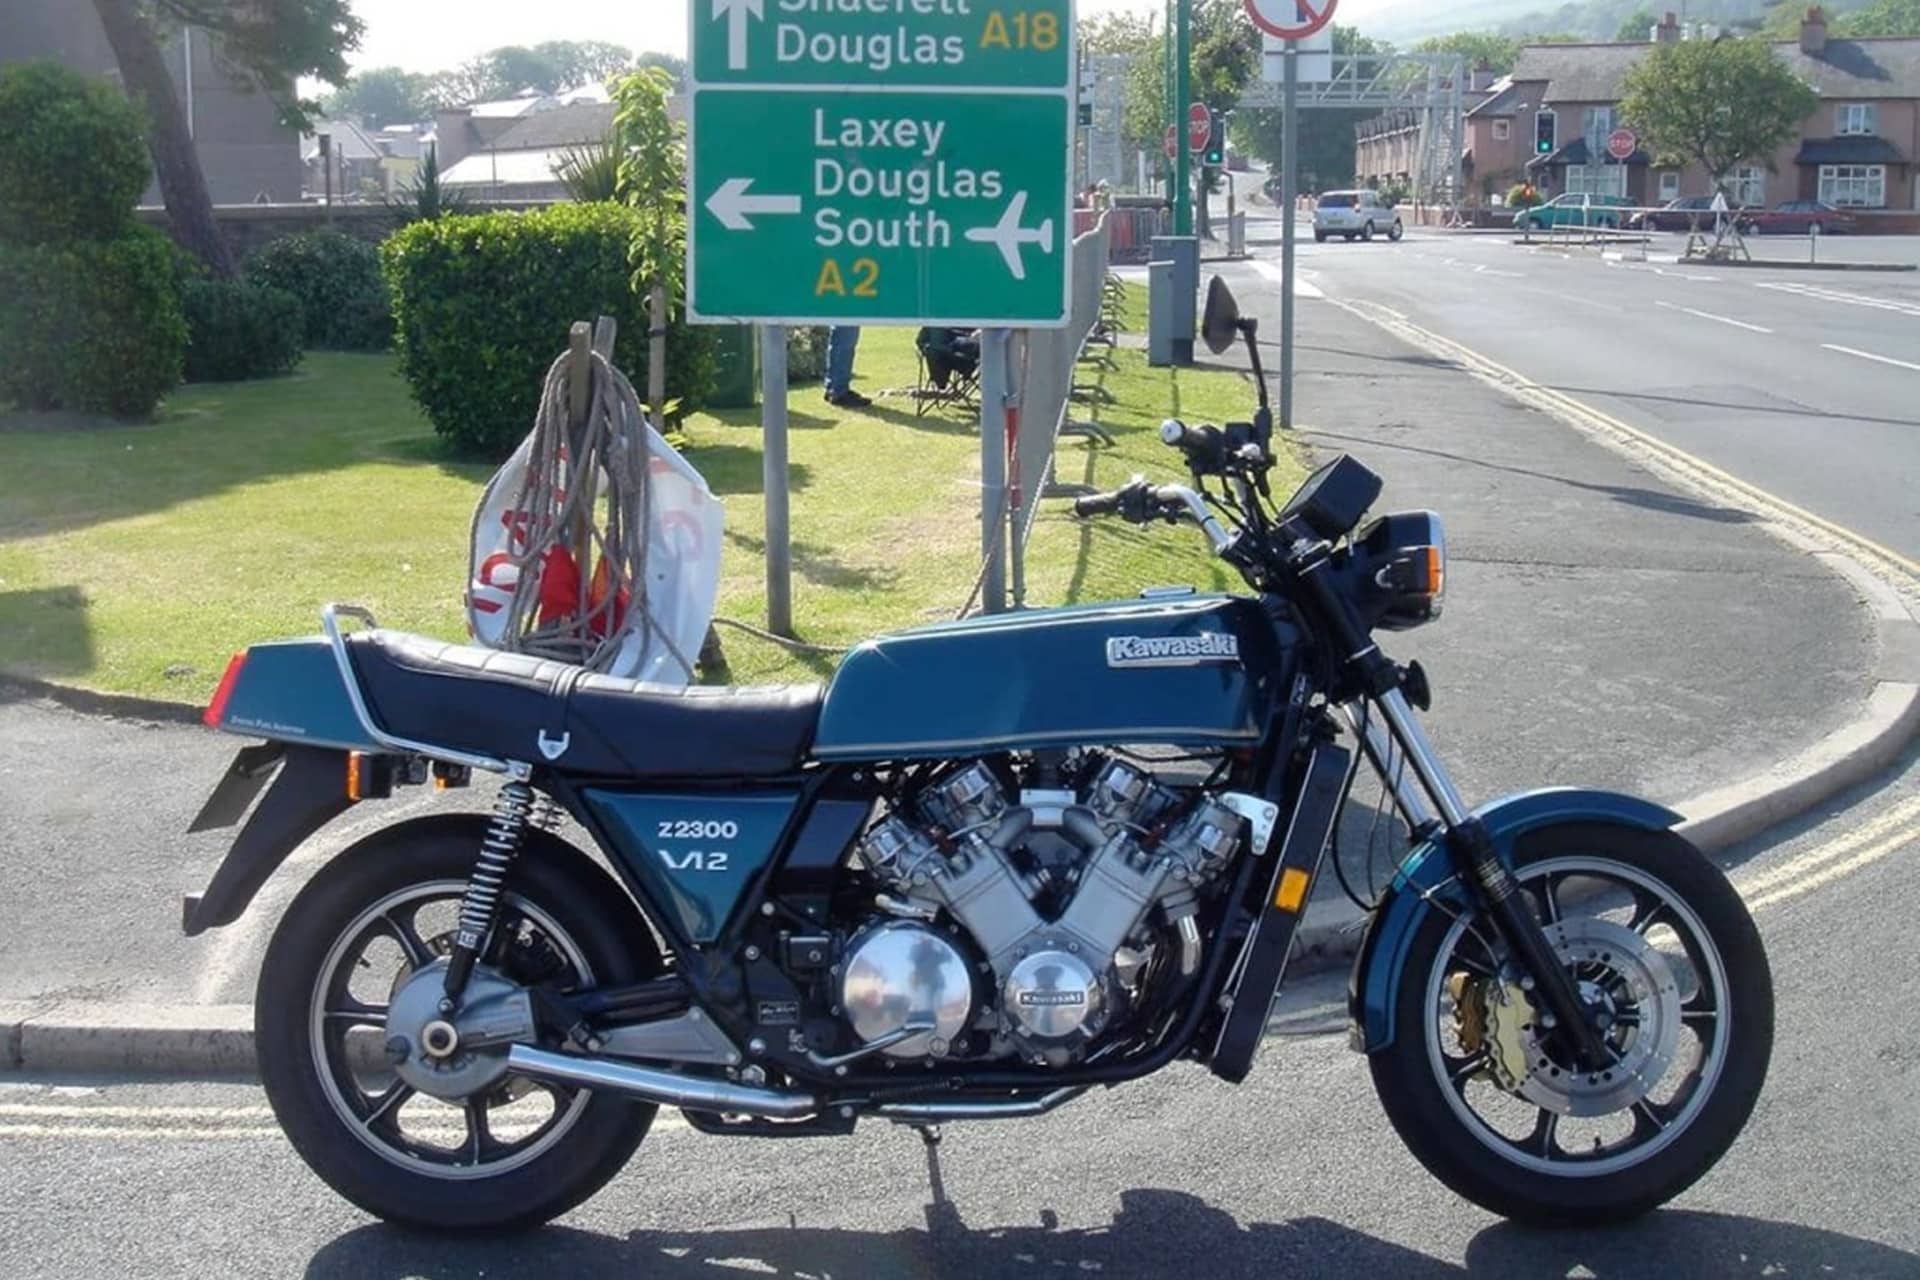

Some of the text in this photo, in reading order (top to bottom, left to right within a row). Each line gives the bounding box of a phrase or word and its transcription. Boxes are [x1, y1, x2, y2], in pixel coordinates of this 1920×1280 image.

[777, 24, 965, 71] Douglas
[980, 10, 1058, 50] A18
[815, 108, 945, 156] Laxey
[1610, 138, 1633, 149] STOP
[814, 158, 1003, 204] Douglas
[814, 208, 951, 247] South
[815, 258, 880, 296] A2
[1114, 633, 1238, 659] Kawasaki
[658, 821, 739, 839] Z2300
[658, 849, 728, 870] V12
